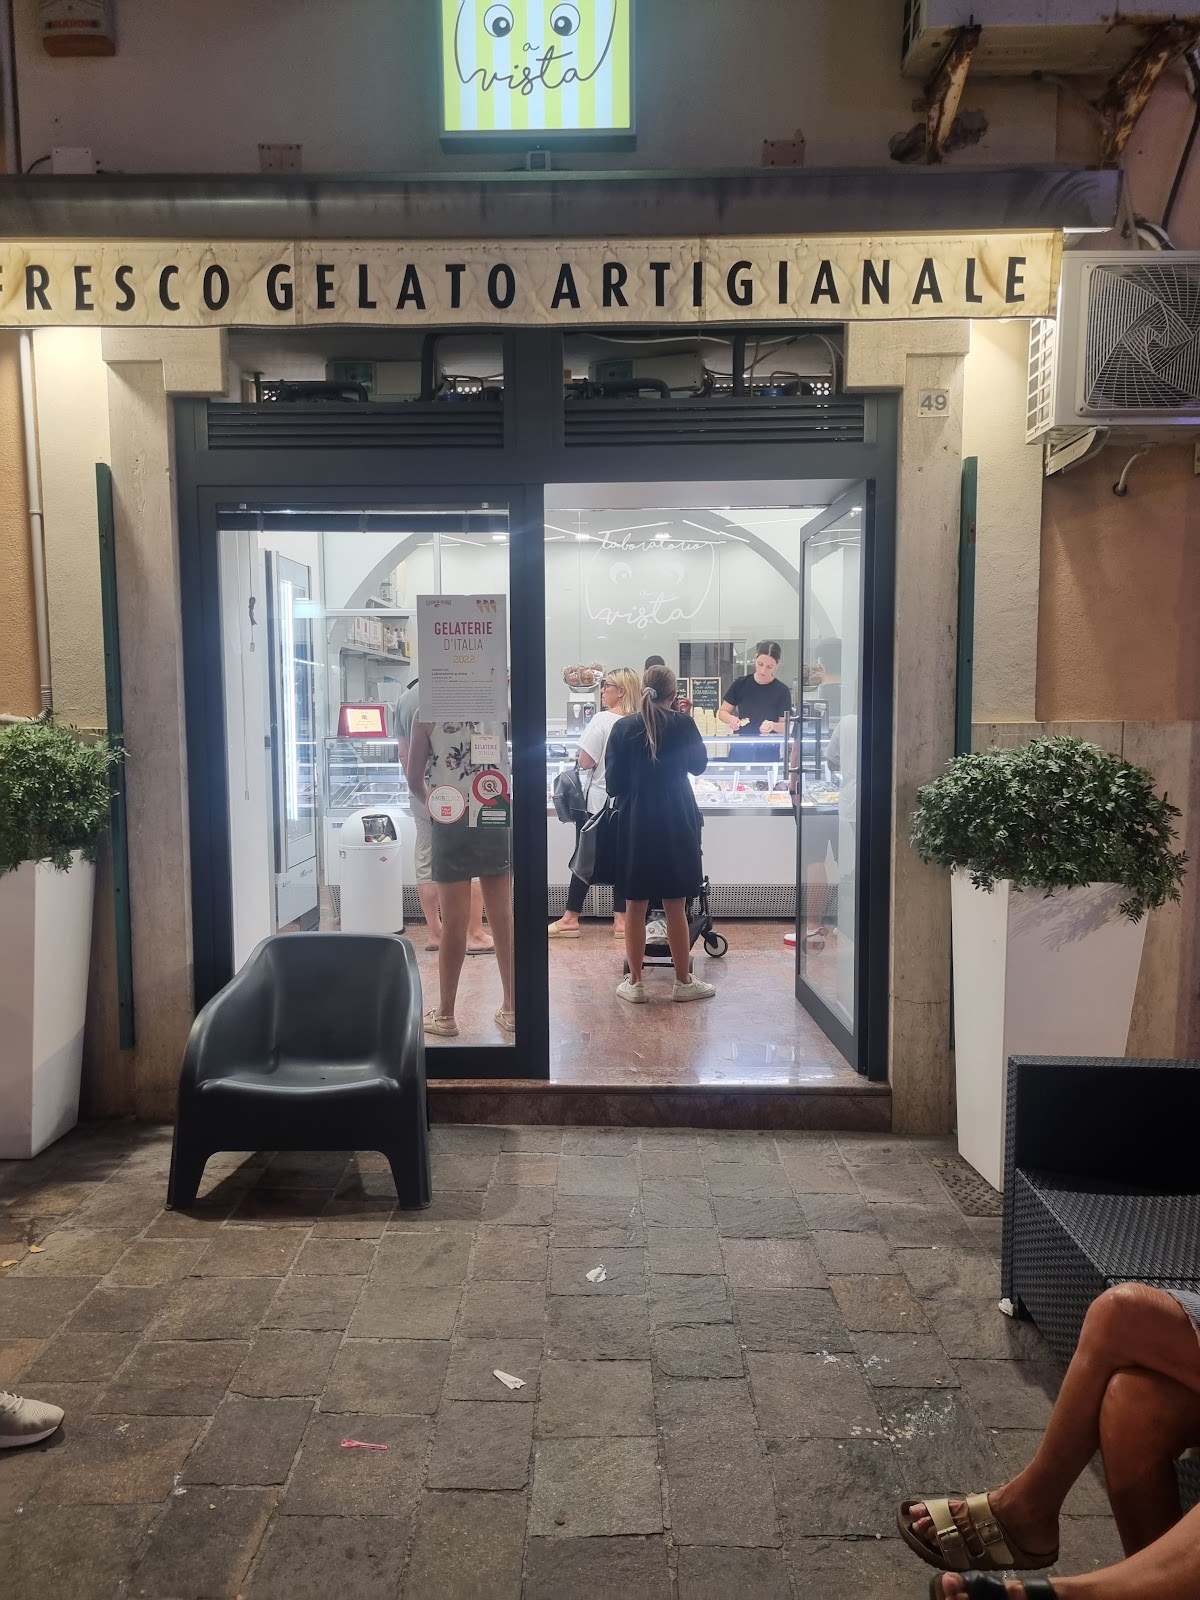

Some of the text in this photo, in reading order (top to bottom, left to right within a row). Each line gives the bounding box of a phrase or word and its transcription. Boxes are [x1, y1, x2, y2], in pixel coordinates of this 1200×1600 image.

[522, 42, 540, 52] a
[470, 44, 584, 96] vista
[0, 255, 1026, 312] RESCO GELATO ARTIGIANALE
[920, 394, 948, 412] 49
[599, 531, 704, 551] laboratorio
[598, 592, 692, 629] vista
[434, 622, 493, 635] GELATERIE
[443, 639, 484, 650] D'ITALIA
[453, 655, 475, 663] 2022
